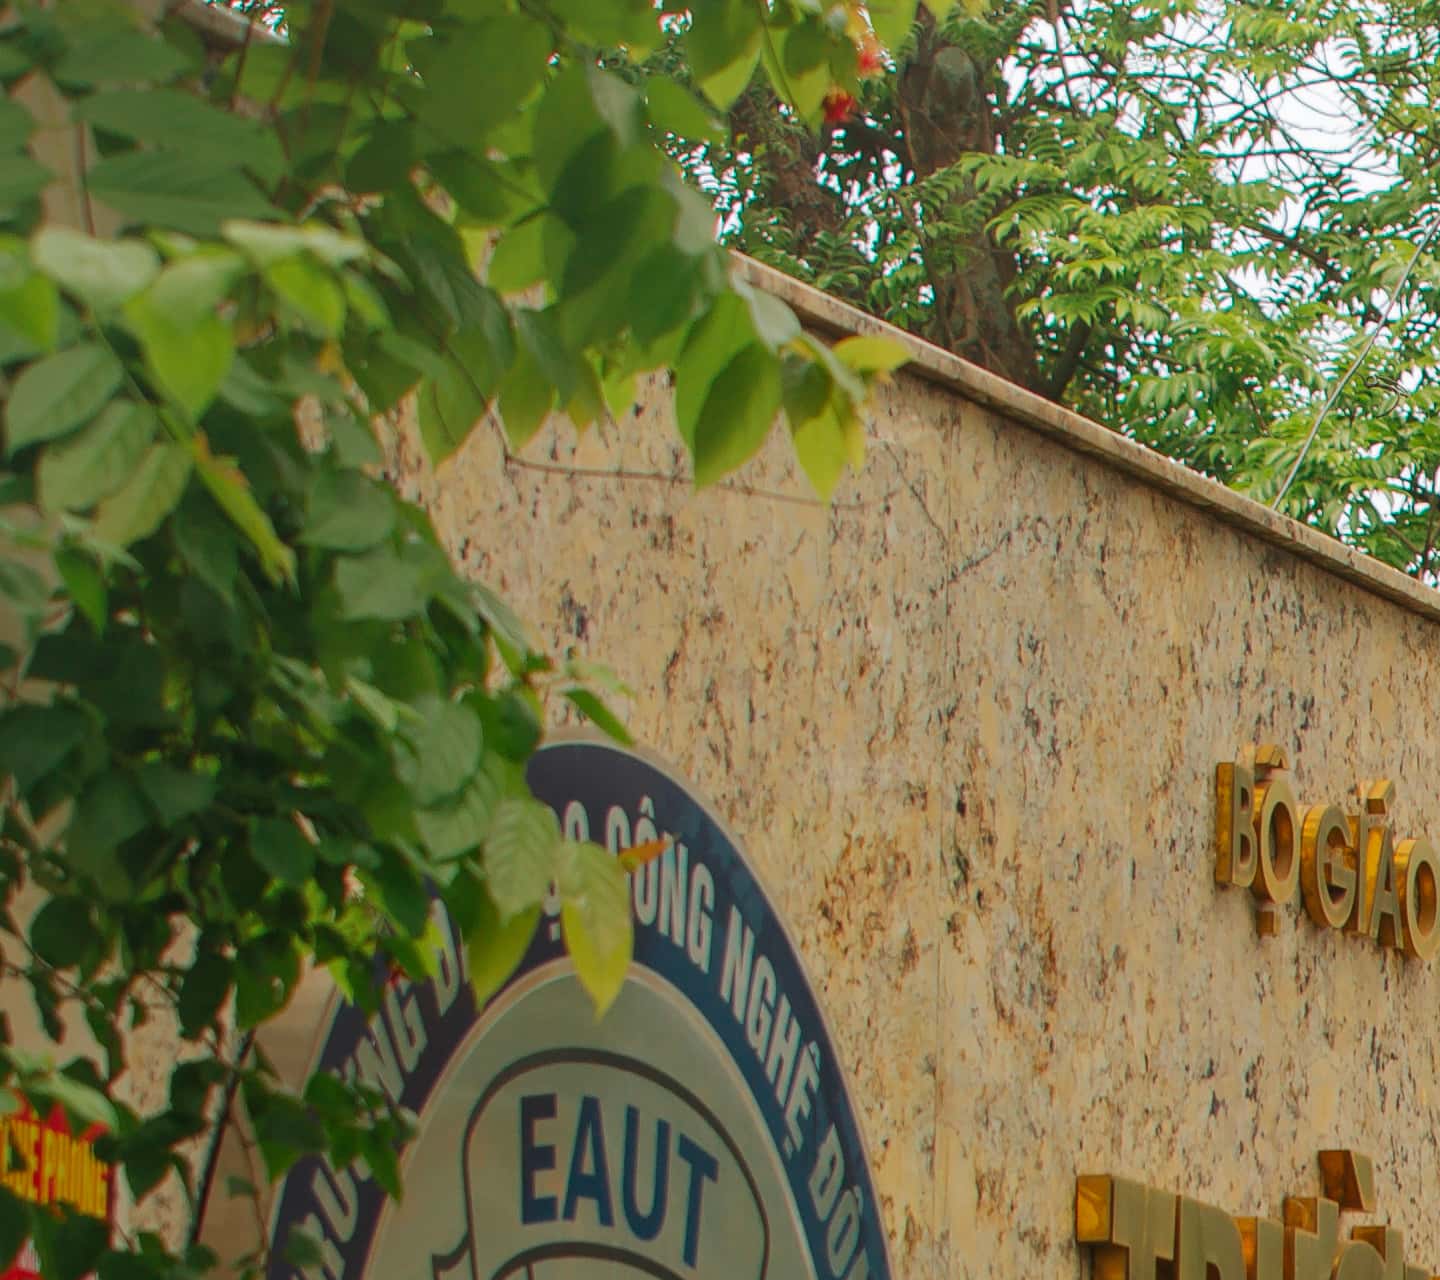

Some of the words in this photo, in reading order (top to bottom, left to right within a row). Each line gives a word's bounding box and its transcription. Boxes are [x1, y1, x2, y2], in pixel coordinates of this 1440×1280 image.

[1216, 745, 1302, 936] BỘ
[719, 900, 825, 1160] NGHỆ
[518, 1092, 720, 1272] EAUT
